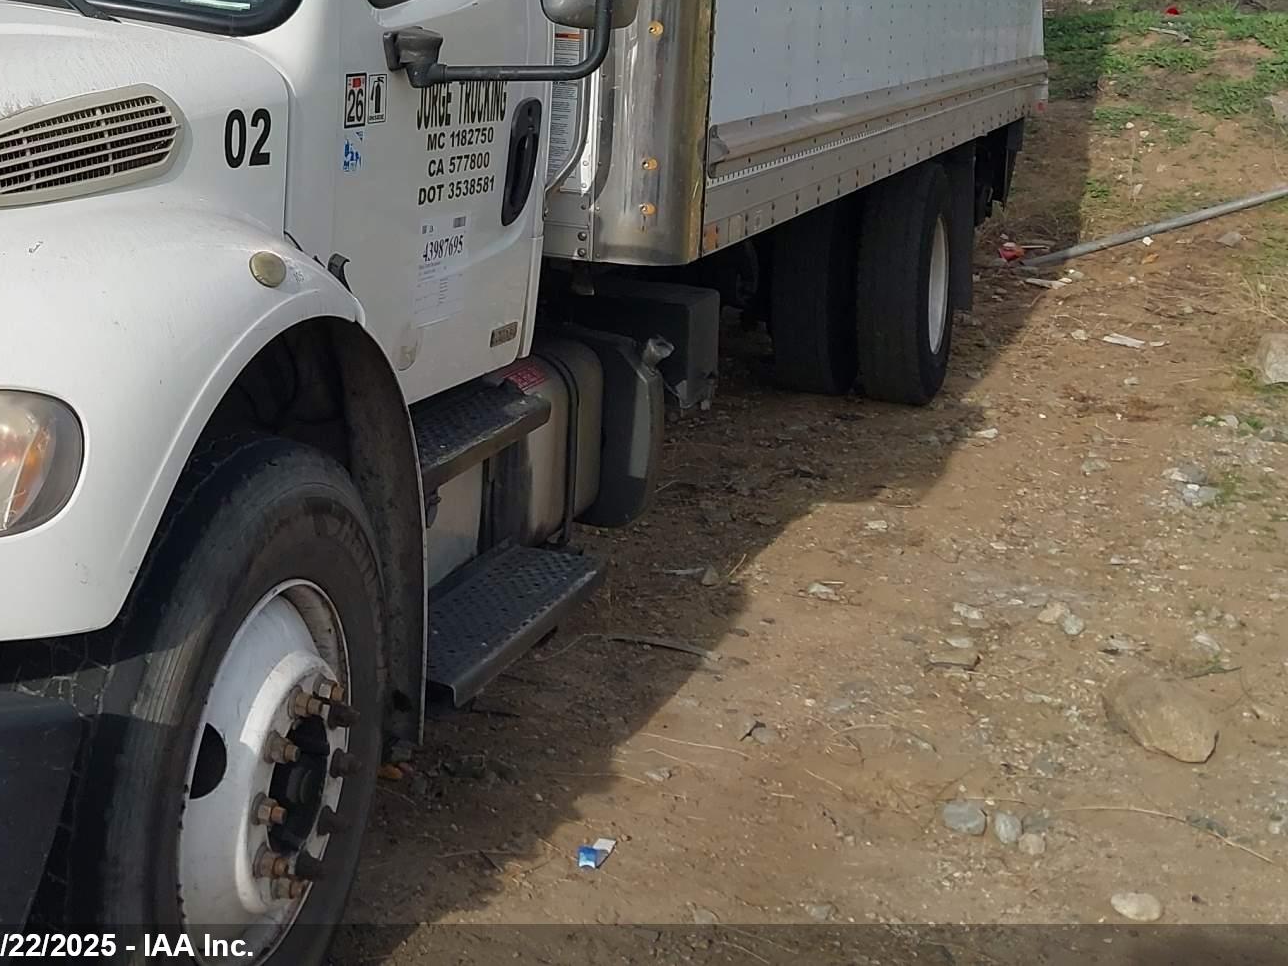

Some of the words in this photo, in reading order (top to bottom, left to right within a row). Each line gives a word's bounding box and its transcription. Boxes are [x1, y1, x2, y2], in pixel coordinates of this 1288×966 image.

[347, 87, 365, 123] 26
[416, 81, 452, 131] JORGE
[457, 80, 508, 125] TRUCKING
[224, 108, 272, 169] 02
[426, 131, 446, 152] MC
[449, 126, 494, 148] 1182750
[427, 158, 445, 178] CA
[448, 151, 491, 174] 577800
[417, 183, 445, 206] DOT
[447, 175, 495, 200] 3538581
[422, 234, 464, 263] 43987695
